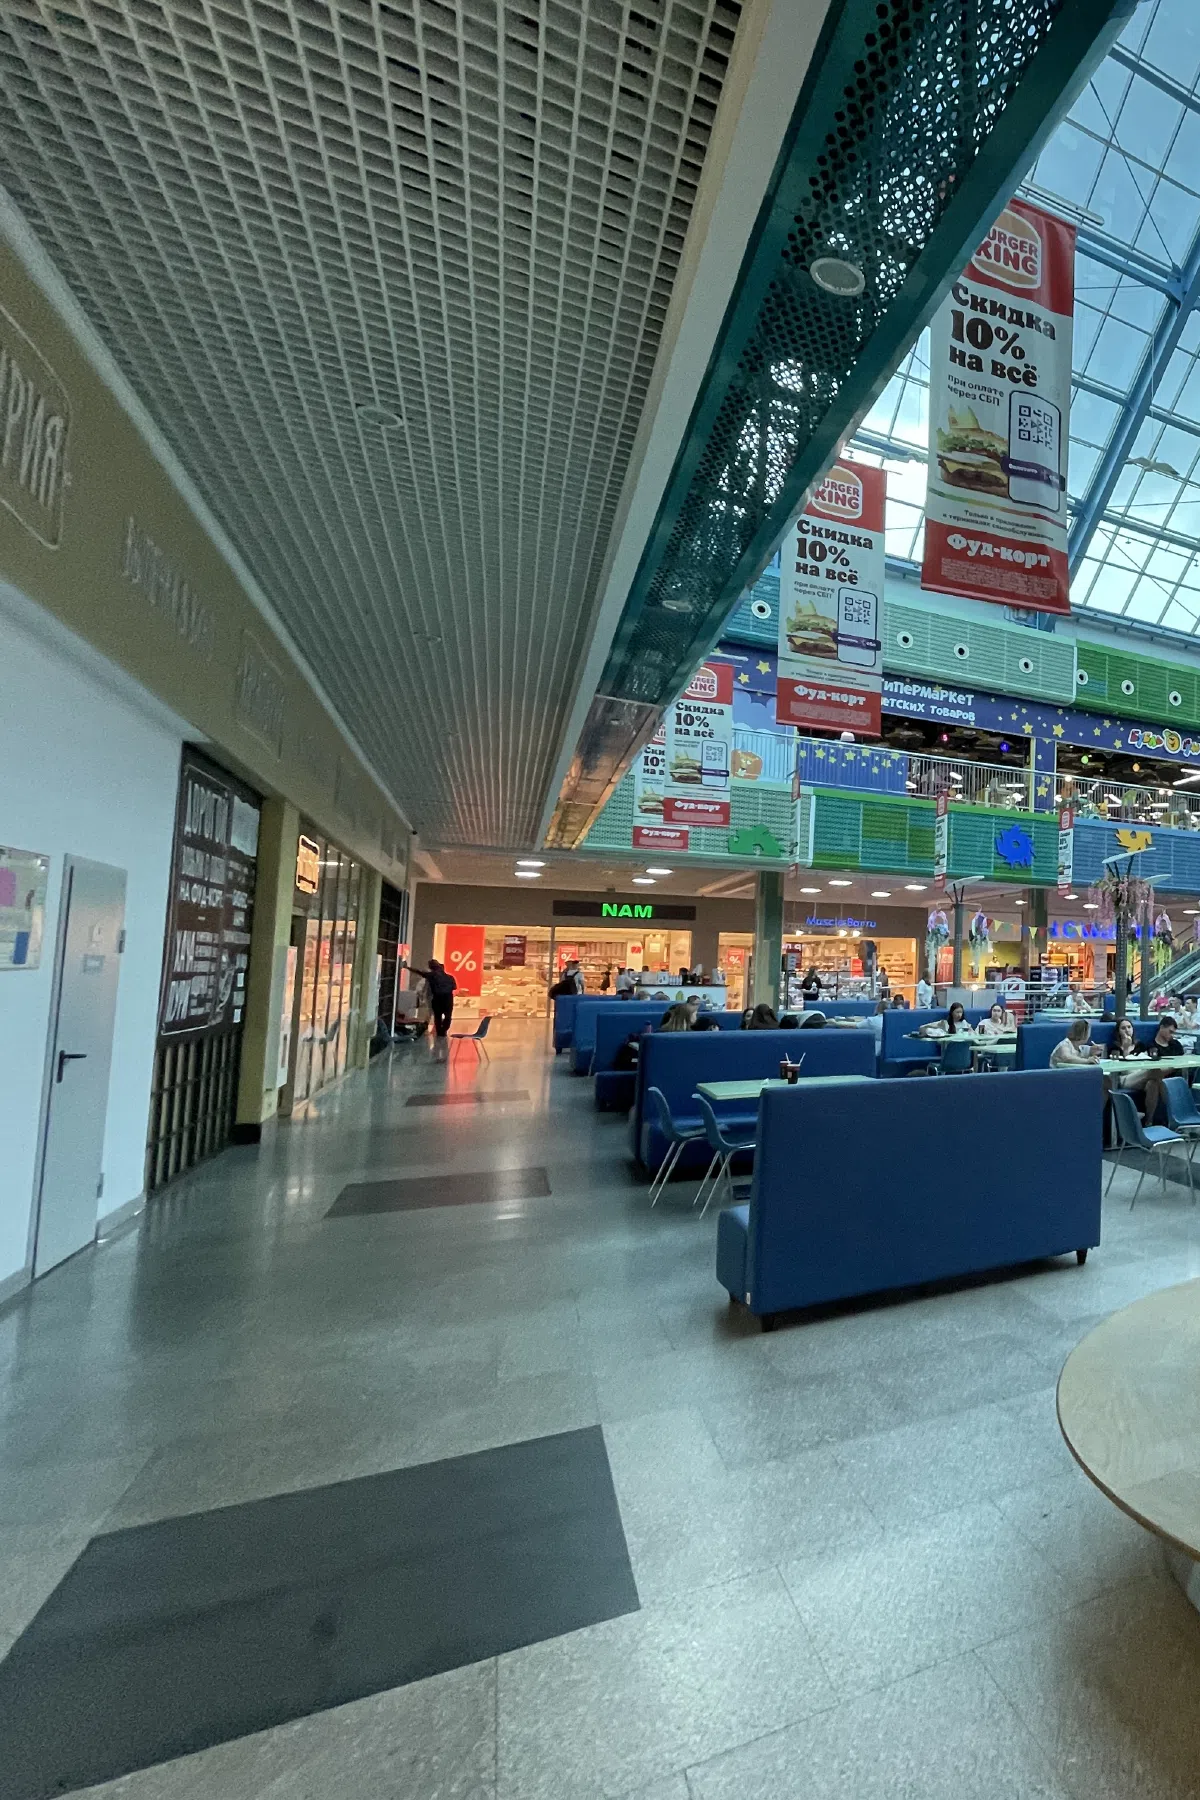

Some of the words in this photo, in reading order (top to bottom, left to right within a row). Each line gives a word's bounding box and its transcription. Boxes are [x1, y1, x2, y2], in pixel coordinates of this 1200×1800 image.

[987, 228, 1038, 258] URGER
[976, 240, 1038, 276] KING
[951, 282, 1055, 340] Скидка
[951, 309, 1026, 360] 10%
[949, 344, 984, 373] на
[990, 363, 1038, 388] всё
[947, 384, 977, 400] через
[978, 393, 1000, 406] СБП
[948, 374, 966, 387] при
[969, 382, 1005, 398] оплате
[0, 350, 64, 507] РИЯ
[814, 488, 860, 510] KING
[822, 480, 859, 497] URGER
[797, 519, 873, 550] Скидка
[796, 537, 850, 567] 10%
[946, 533, 1050, 569] Фуд-корт
[795, 562, 820, 577] на
[825, 569, 859, 586] всё
[793, 684, 867, 707] Фуд-корт
[881, 696, 925, 713] етских
[675, 702, 724, 716] Скидка
[675, 712, 709, 728] 10%
[674, 727, 690, 736] на
[601, 903, 653, 919] NAM
[450, 950, 477, 972] %
